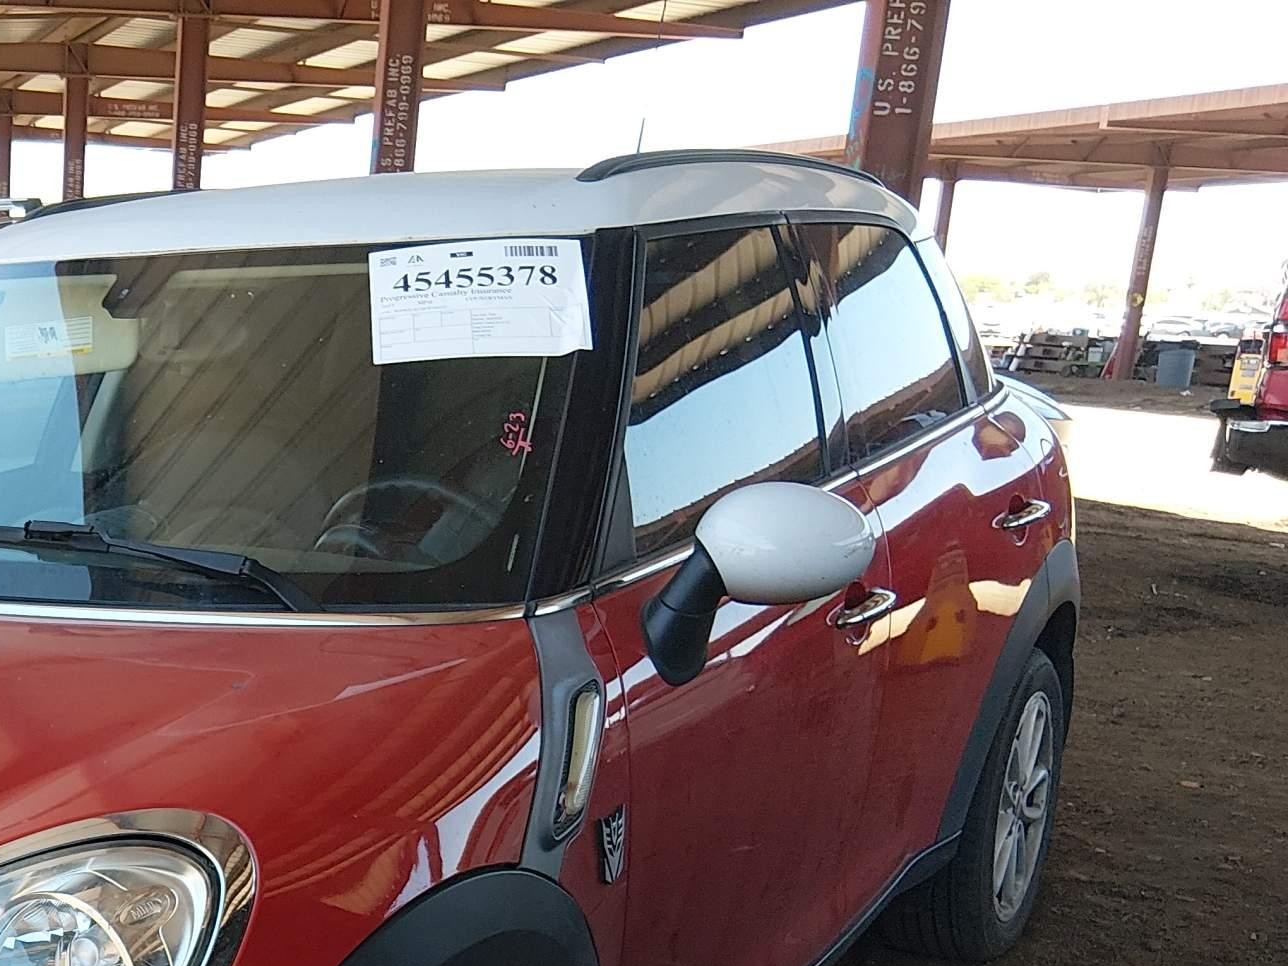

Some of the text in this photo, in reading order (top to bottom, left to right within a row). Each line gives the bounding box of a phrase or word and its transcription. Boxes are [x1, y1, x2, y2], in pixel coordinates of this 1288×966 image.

[388, 53, 402, 82] INC.
[383, 89, 399, 146] PREFAB
[393, 265, 558, 292] 45455378
